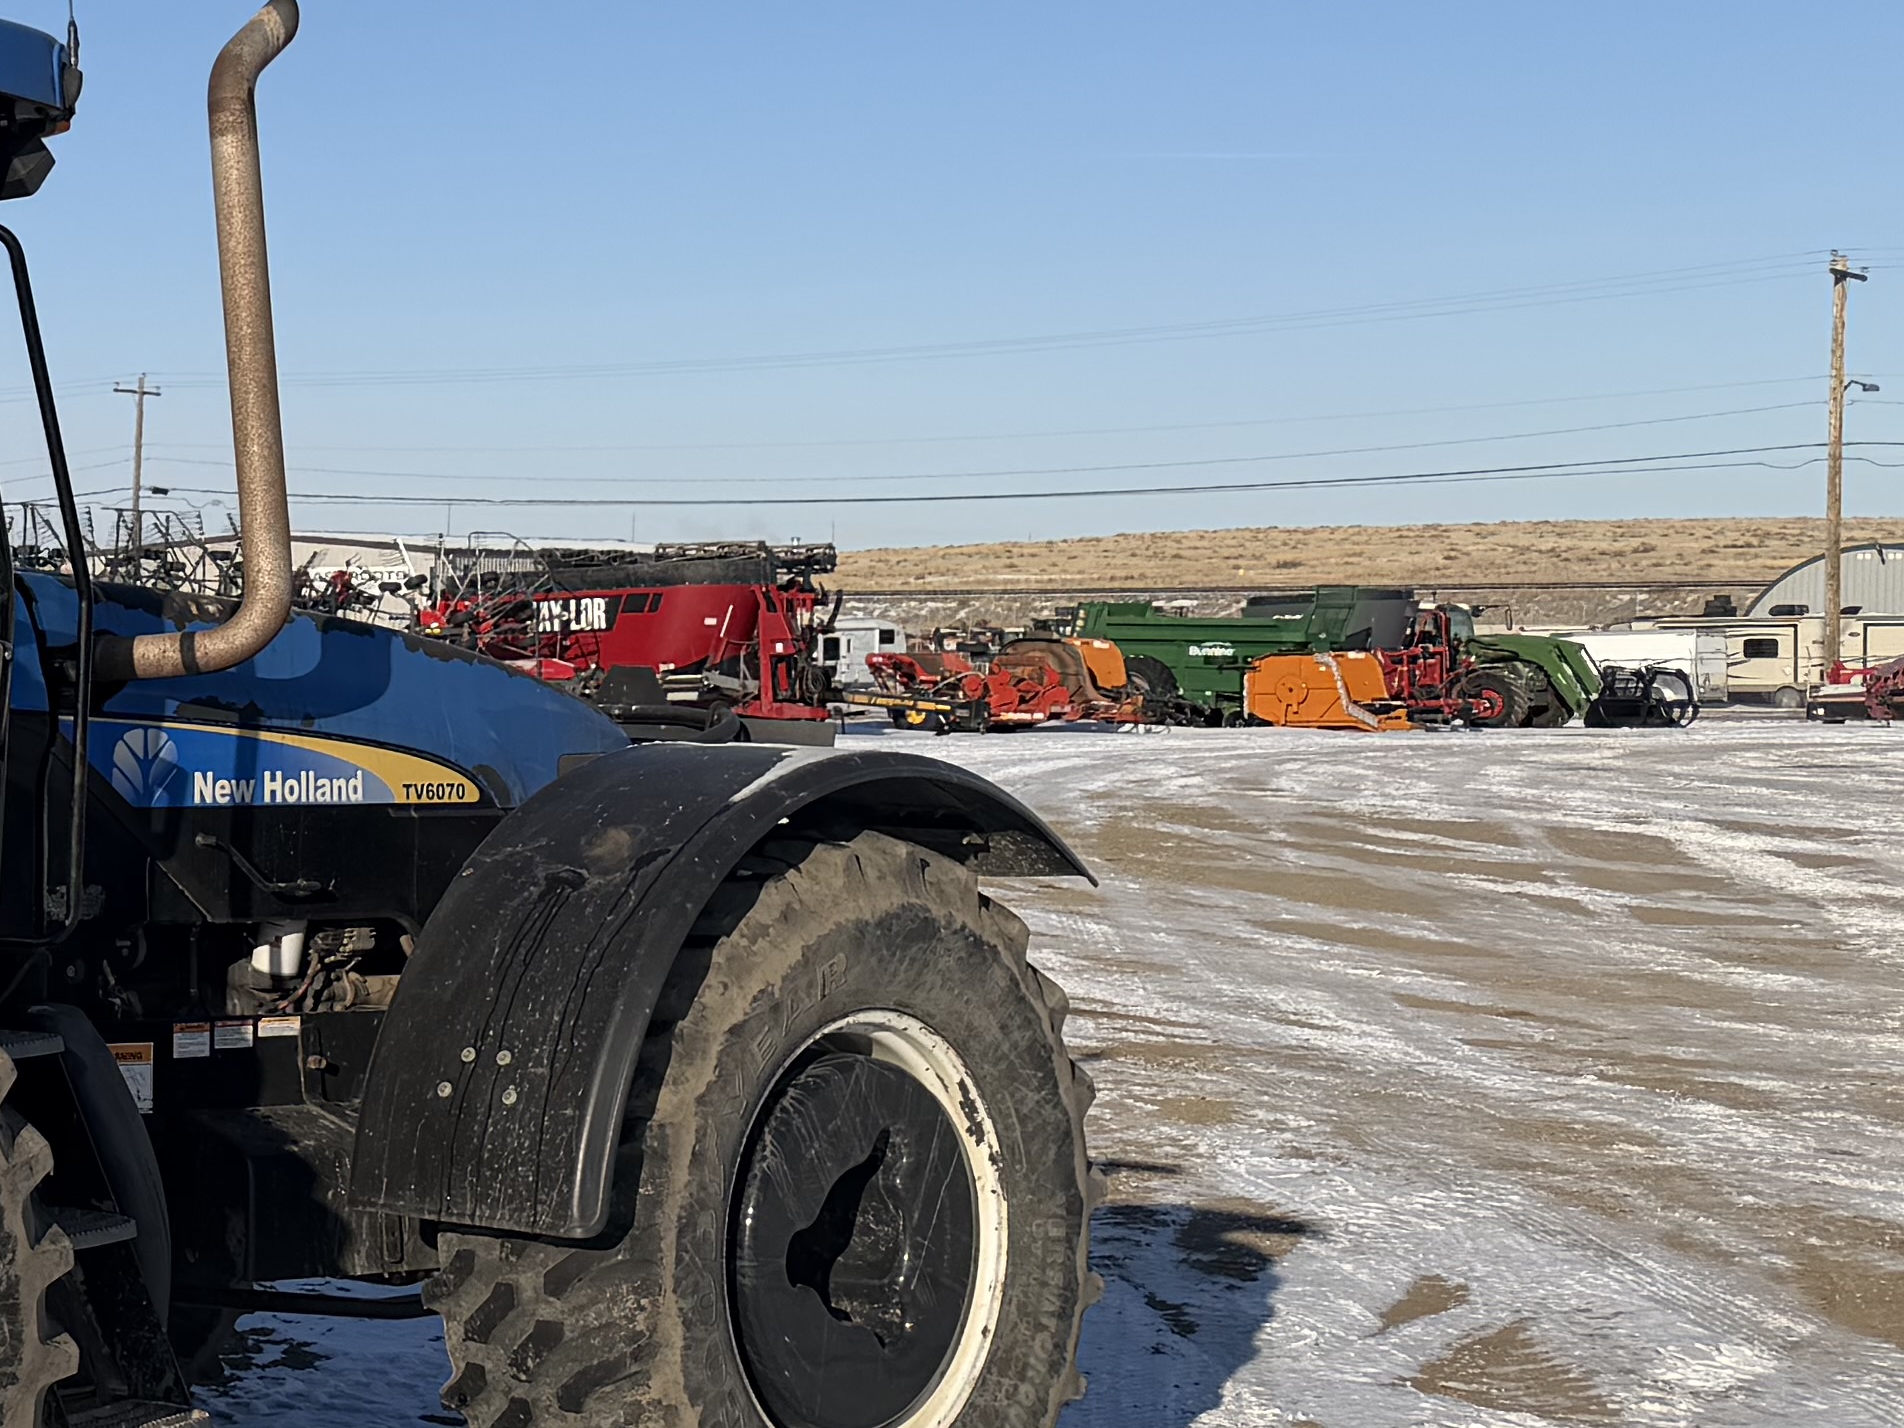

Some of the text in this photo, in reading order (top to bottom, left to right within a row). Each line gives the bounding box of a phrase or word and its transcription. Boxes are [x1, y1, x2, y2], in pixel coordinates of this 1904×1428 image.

[532, 597, 606, 632] AY-LOR
[193, 770, 364, 804] New Holland
[402, 782, 465, 800] TV6070
